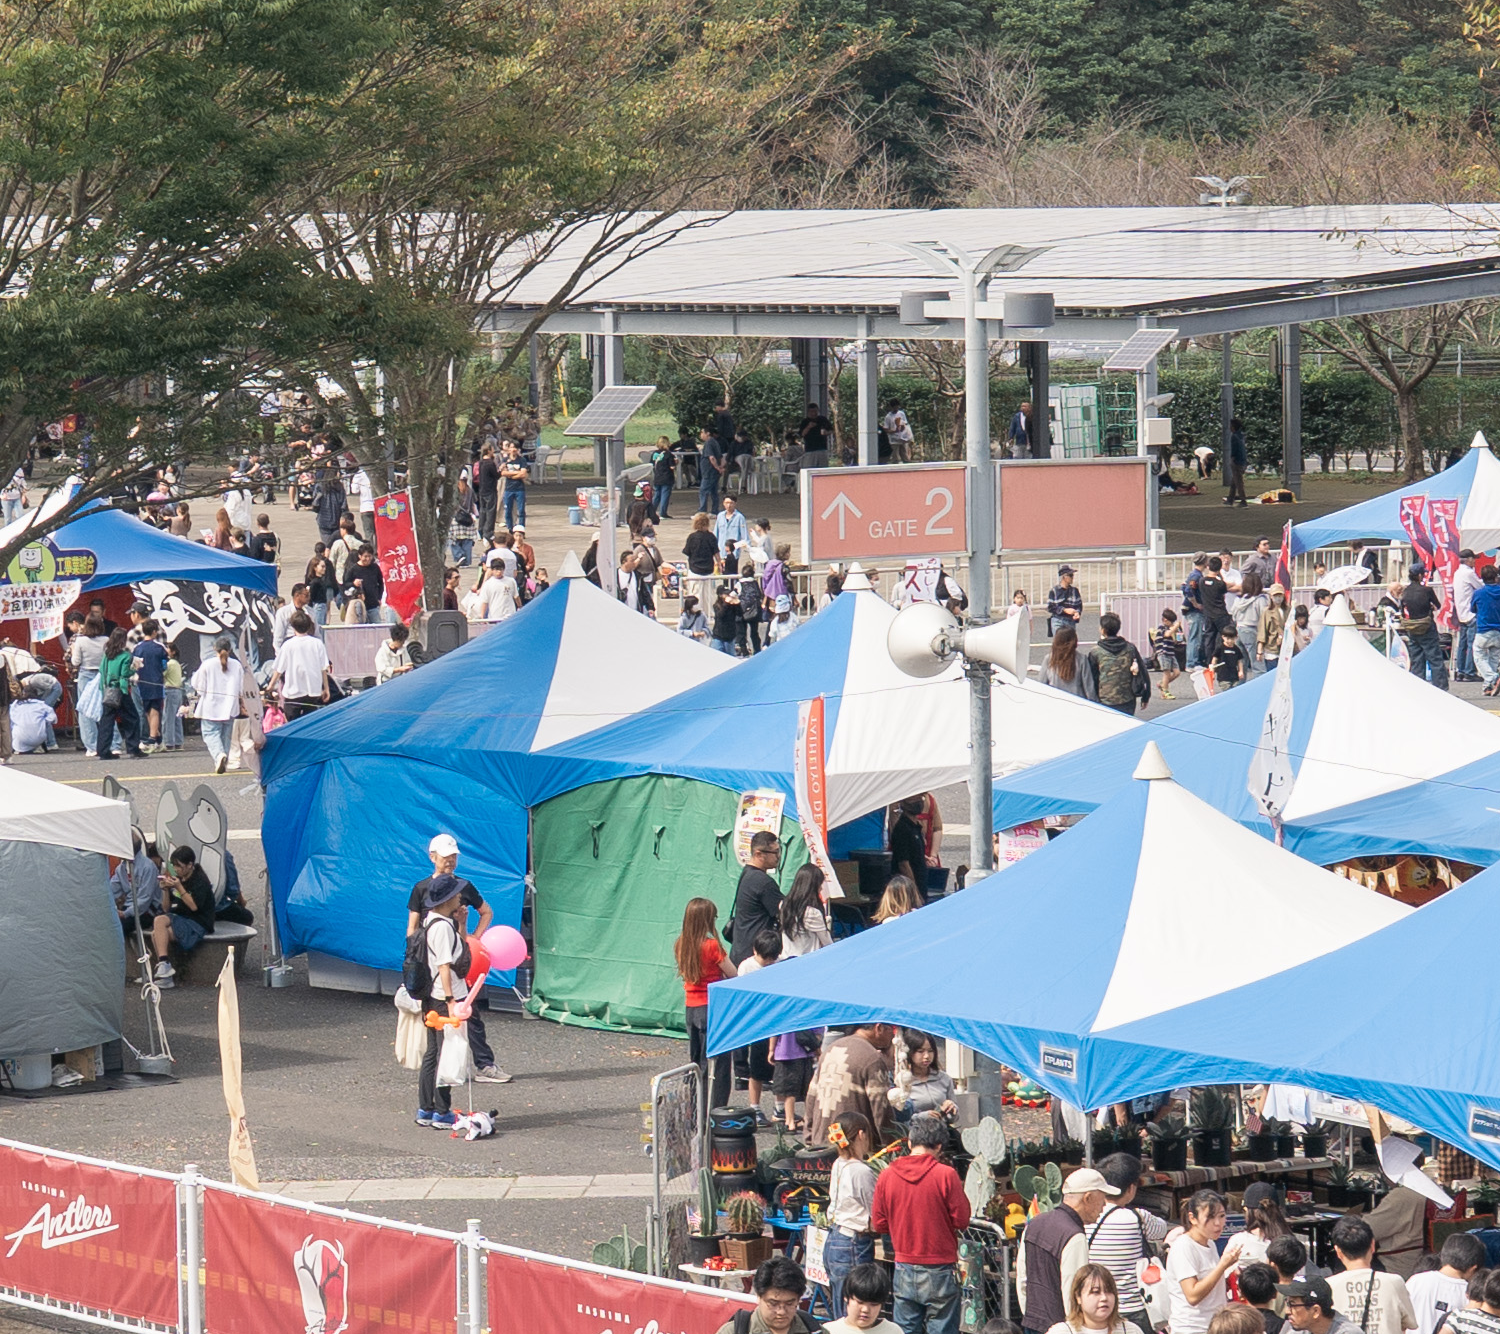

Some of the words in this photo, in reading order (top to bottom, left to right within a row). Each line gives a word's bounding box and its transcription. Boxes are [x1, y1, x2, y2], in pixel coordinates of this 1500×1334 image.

[868, 518, 918, 541] GATE
[923, 487, 956, 537] 2
[4, 1194, 120, 1258] Antlers
[1345, 1278, 1382, 1293] GOOD
[576, 1303, 631, 1326] KASHIMA
